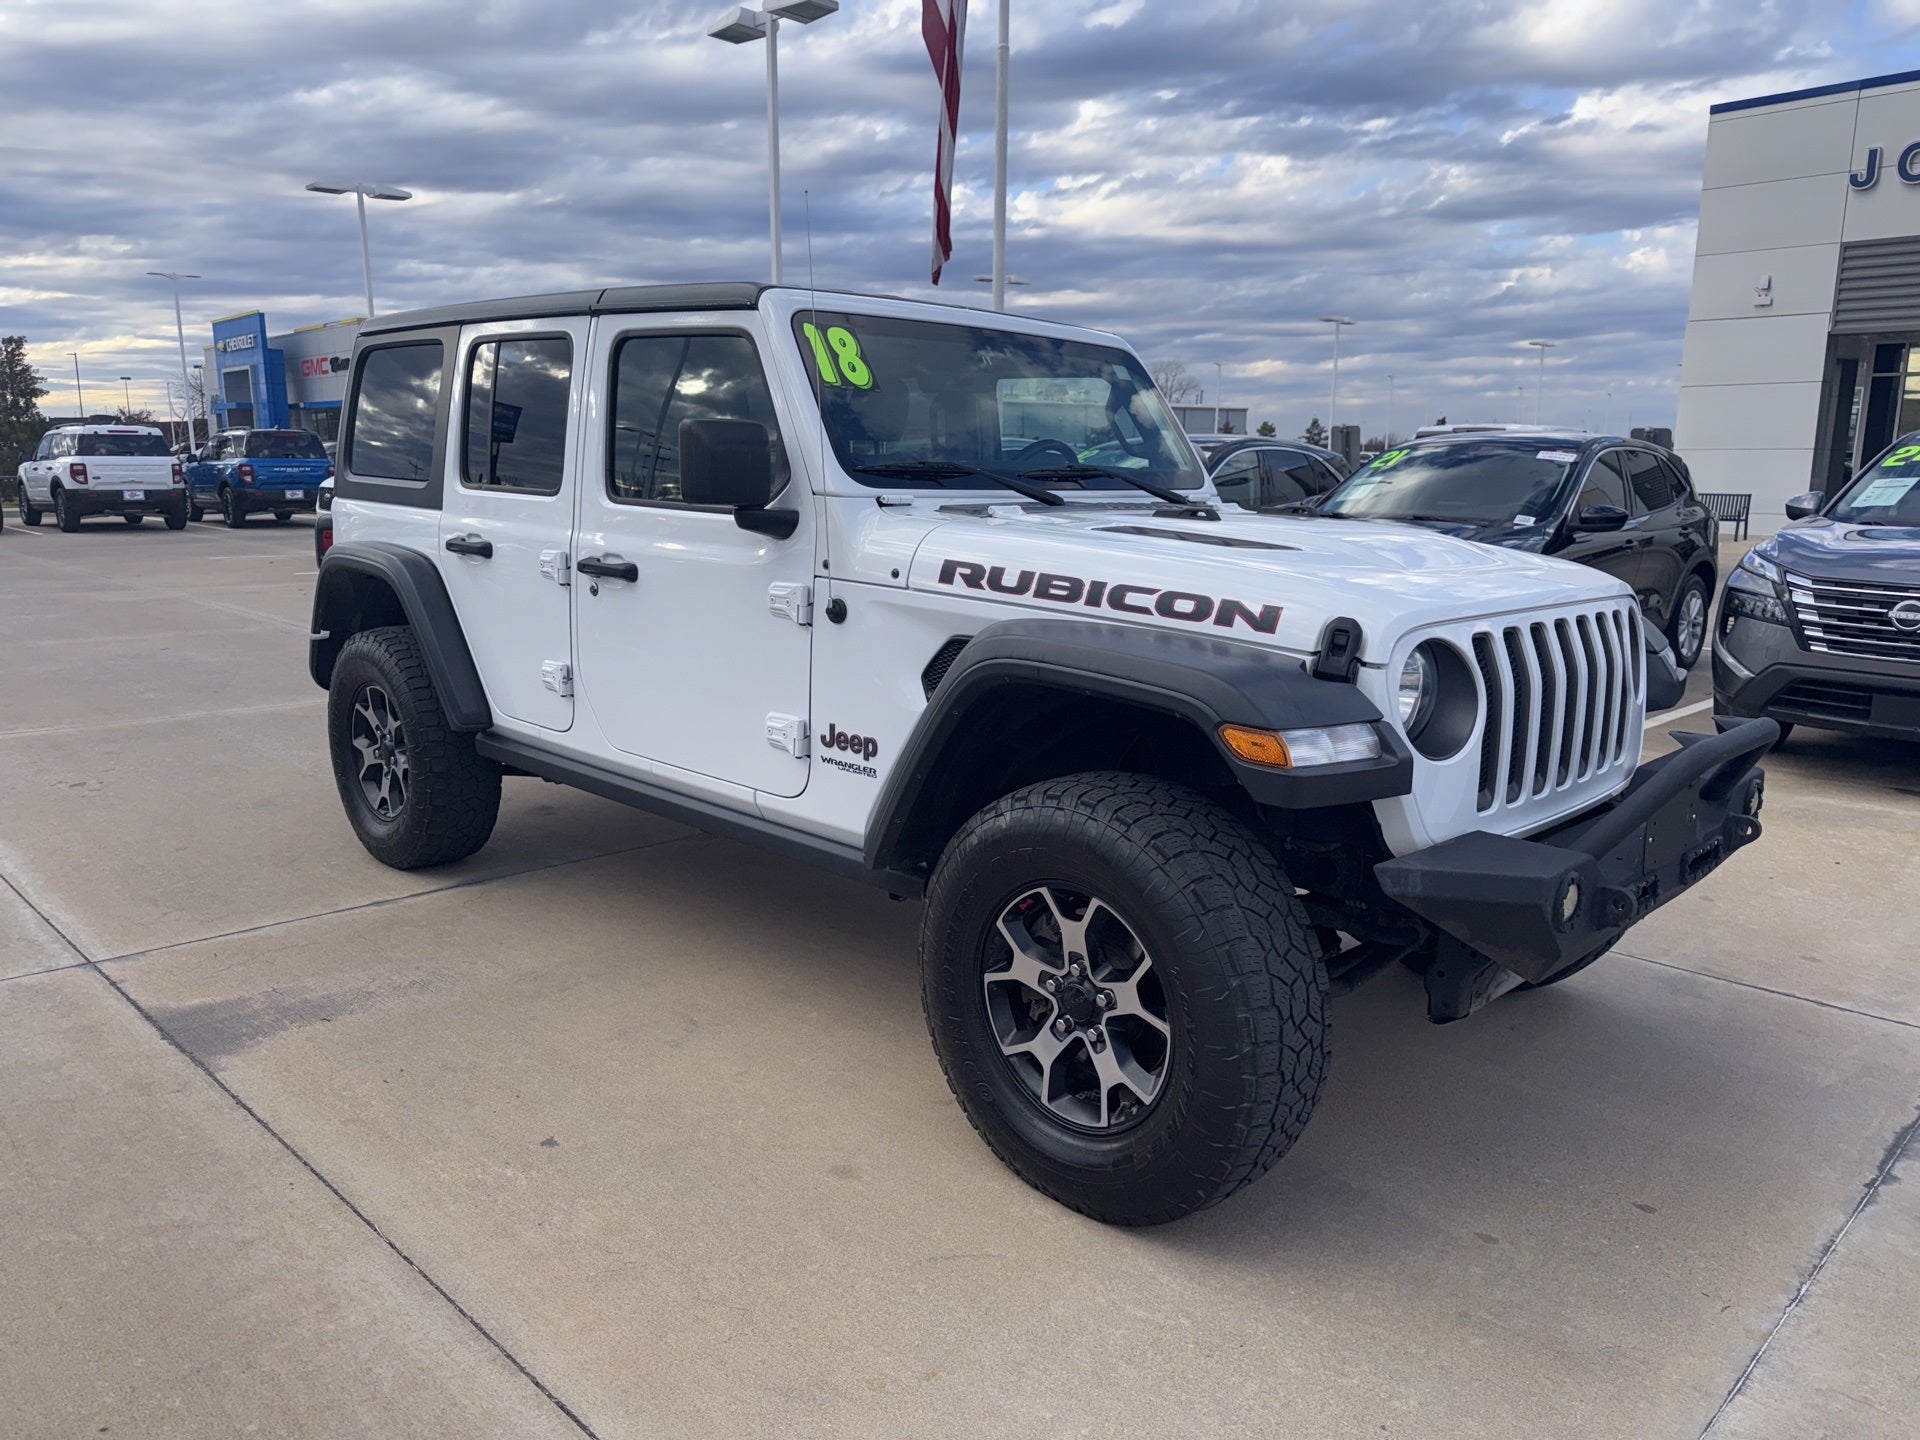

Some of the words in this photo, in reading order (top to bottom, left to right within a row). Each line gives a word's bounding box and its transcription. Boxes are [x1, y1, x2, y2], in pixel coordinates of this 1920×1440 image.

[226, 333, 256, 352] CHEVROLET
[802, 322, 873, 389] 18
[301, 356, 330, 377] GMC
[1369, 449, 1411, 470] 21
[1881, 445, 1920, 467] 2
[937, 558, 1285, 635] RUBICON
[820, 722, 878, 762] Jeep
[820, 755, 877, 775] WRANGLER
[837, 766, 878, 779] UNLIMITED
